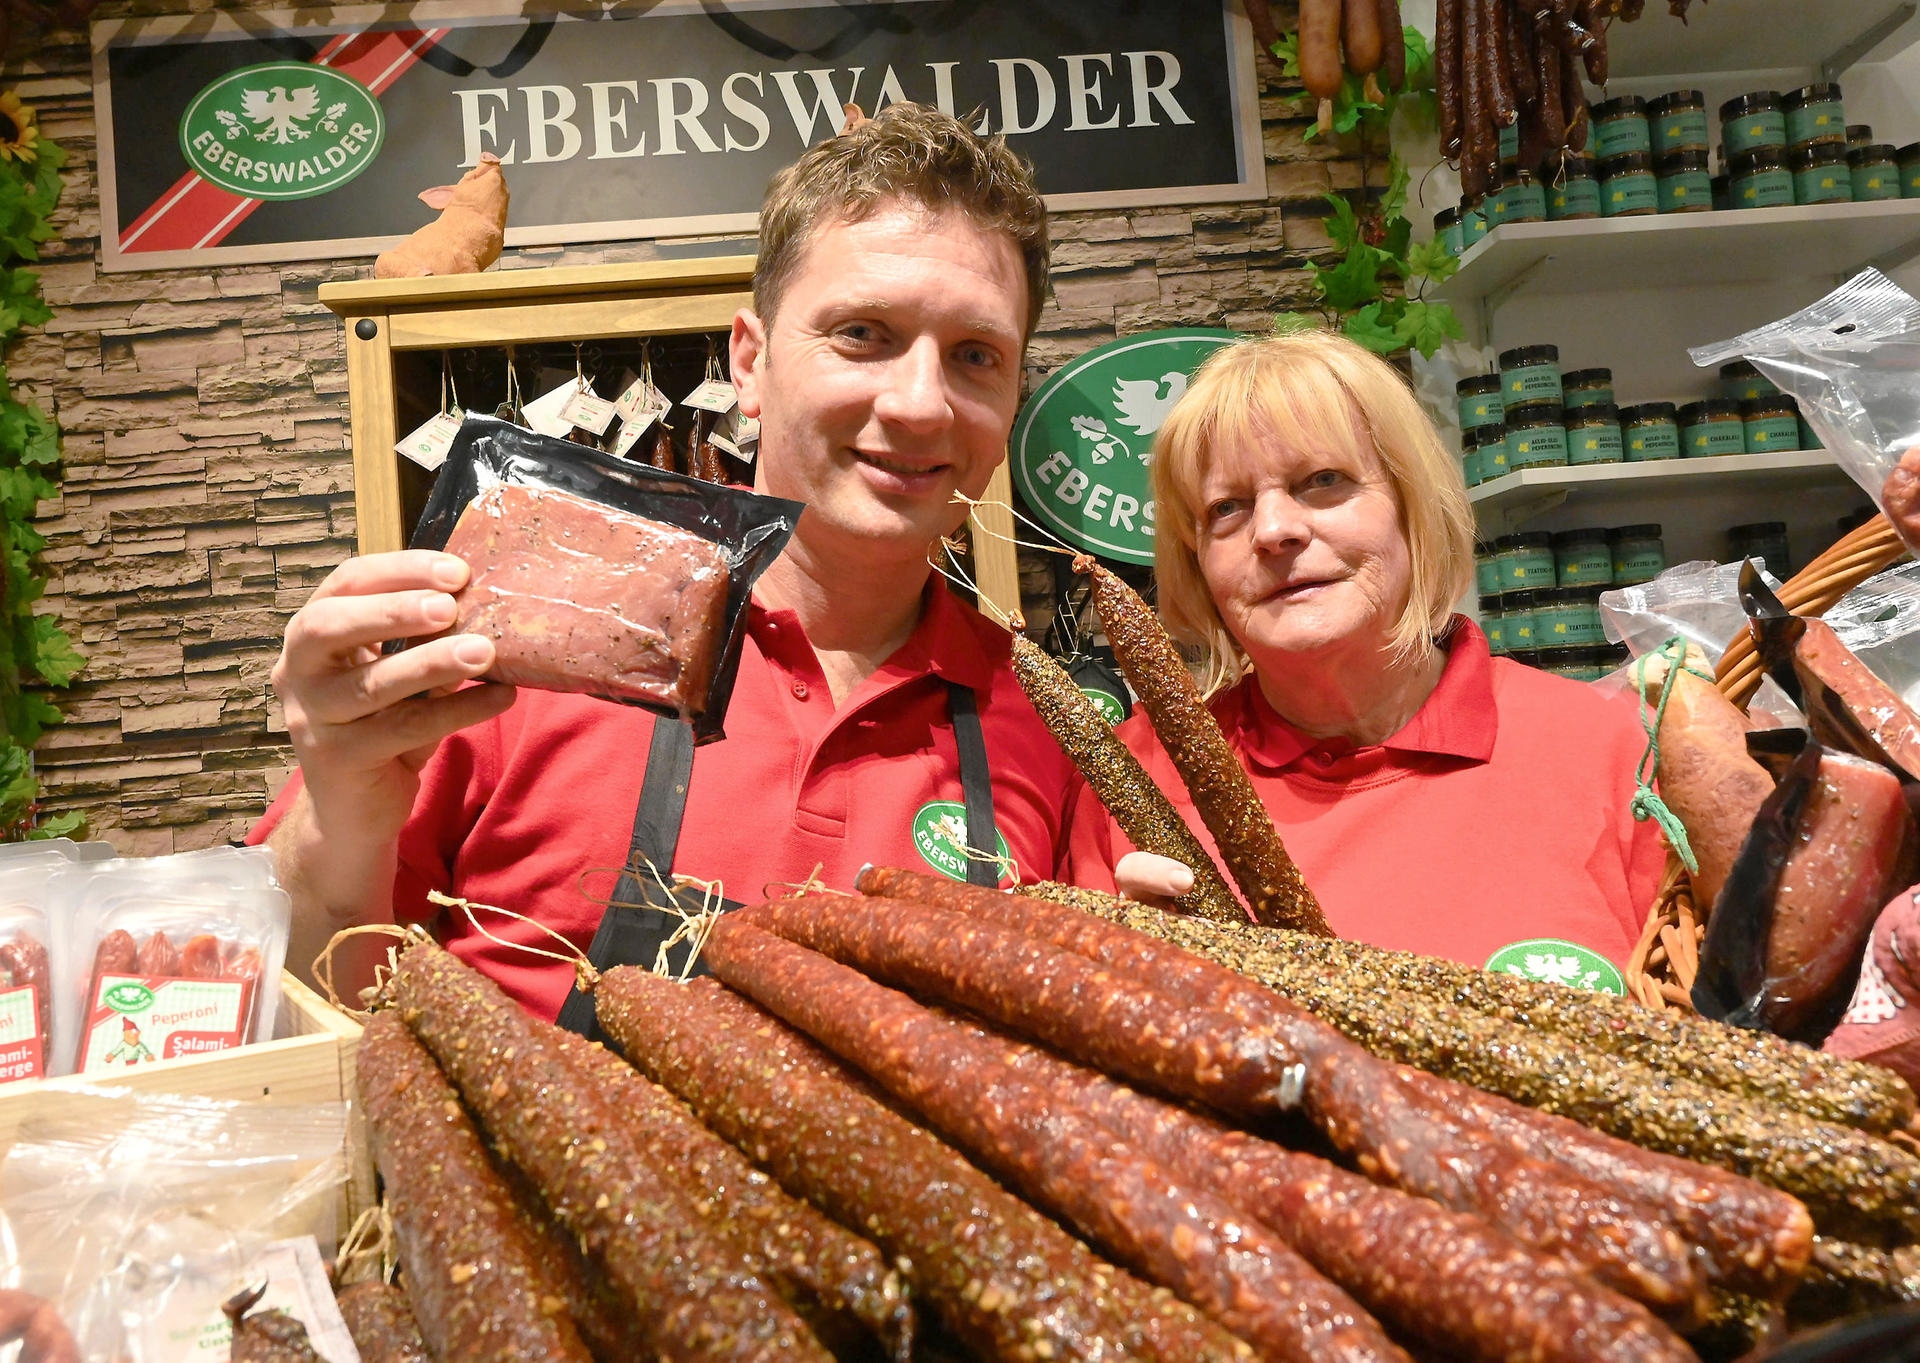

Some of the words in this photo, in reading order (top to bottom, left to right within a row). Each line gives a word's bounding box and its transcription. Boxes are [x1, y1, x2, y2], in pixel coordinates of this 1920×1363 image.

[452, 49, 1195, 169] EBERSWALDER
[191, 120, 374, 185] EBERSWALDER
[151, 1002, 219, 1027] Peperoni
[172, 1036, 230, 1052] Salami-
